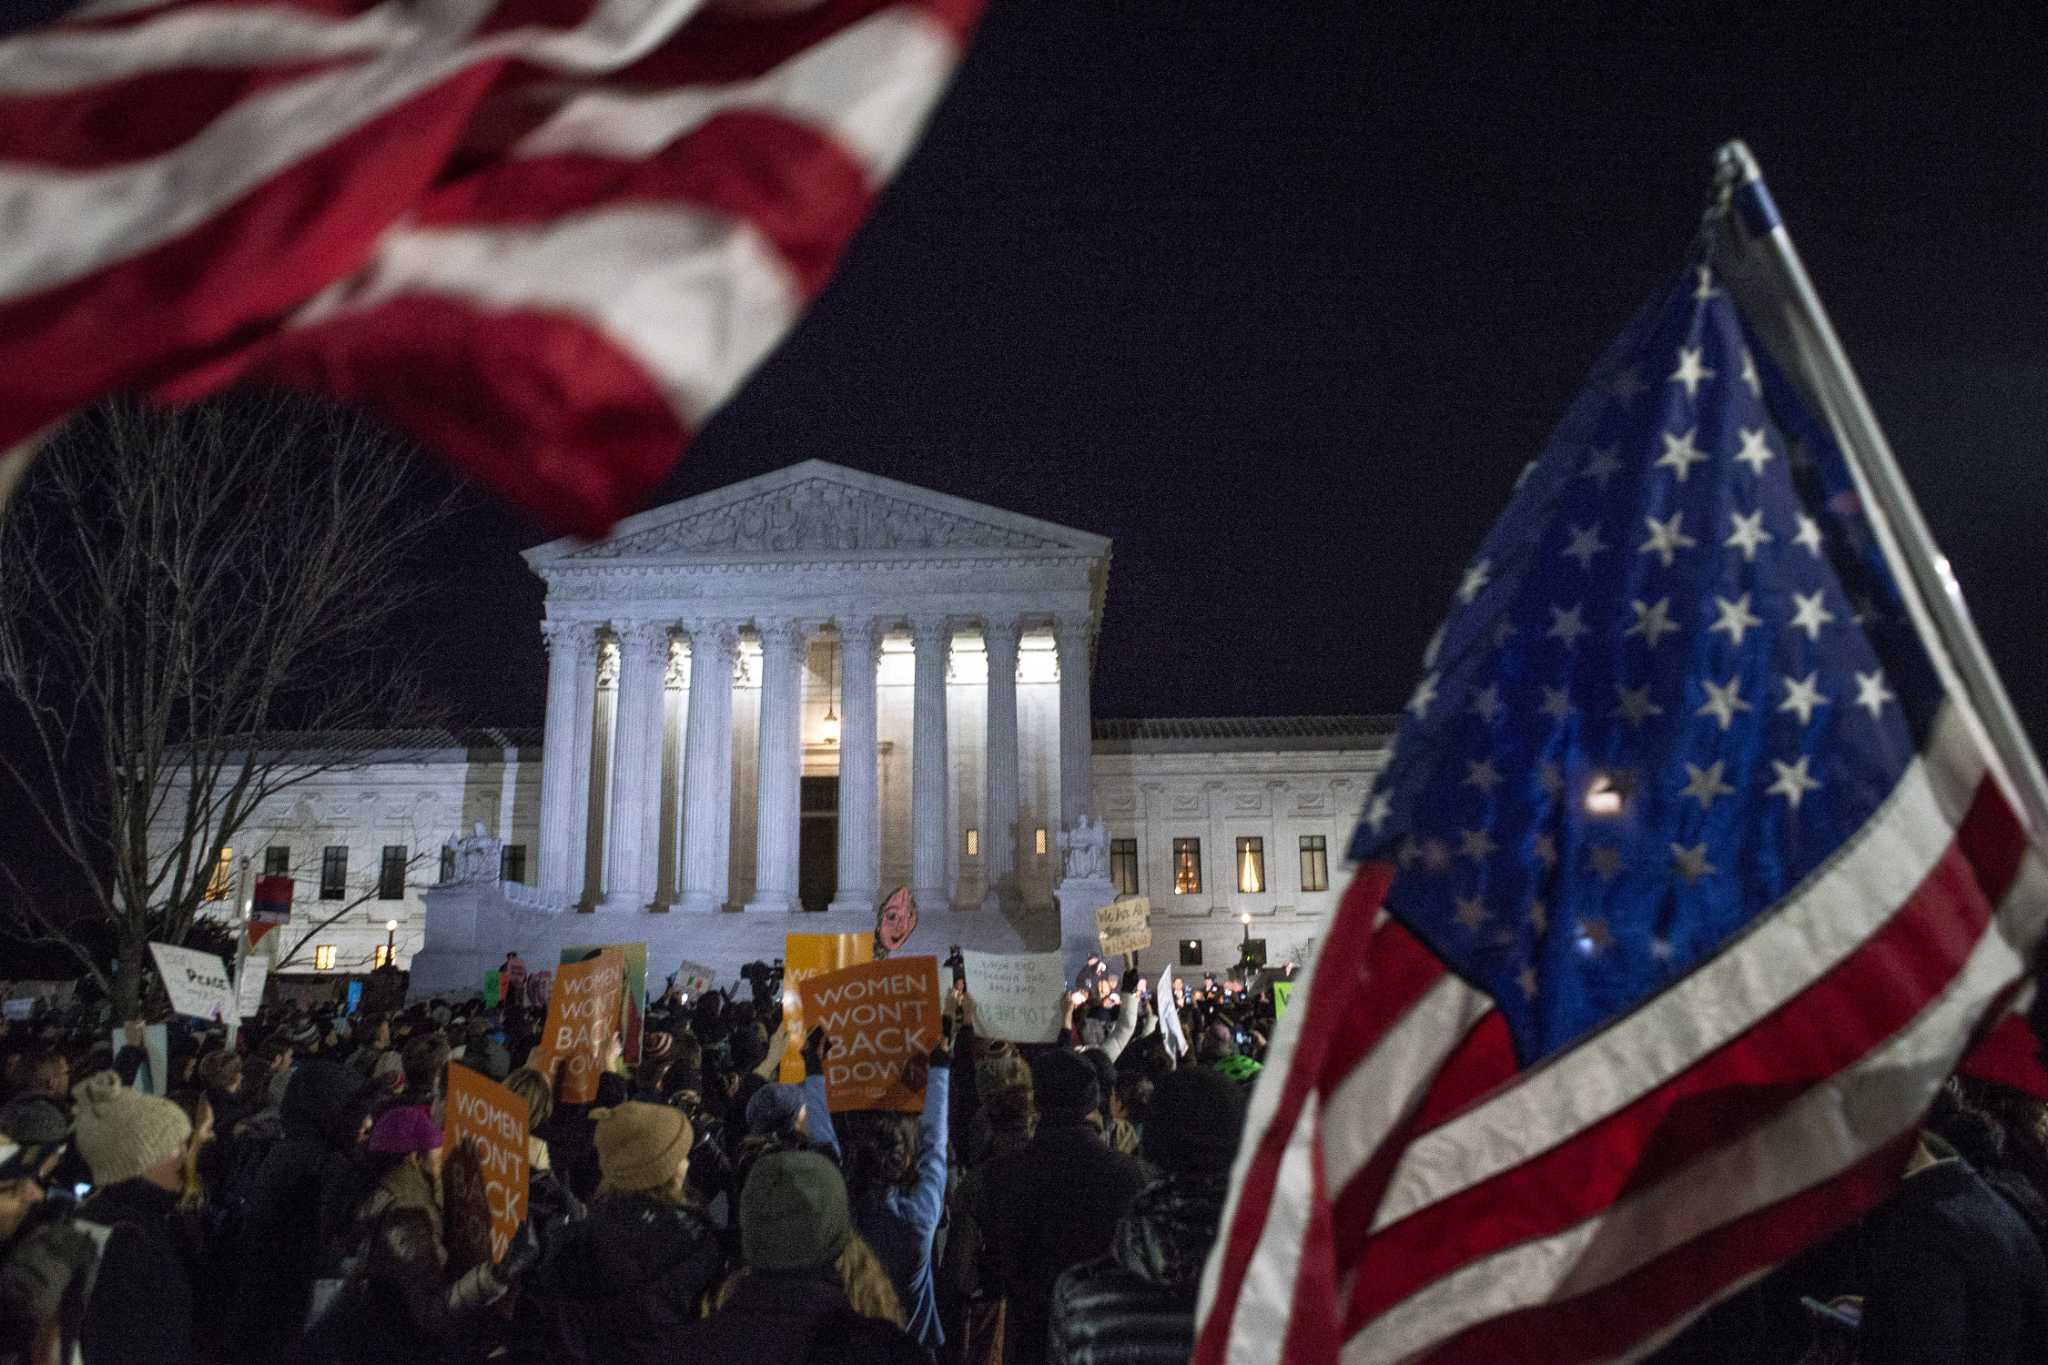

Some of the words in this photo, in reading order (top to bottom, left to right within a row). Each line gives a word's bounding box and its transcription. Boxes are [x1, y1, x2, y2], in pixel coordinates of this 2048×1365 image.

[815, 974, 928, 1008] WOMEN
[819, 999, 929, 1031] WON'T
[827, 1026, 930, 1061] BACK
[455, 1089, 525, 1148] WOMEN
